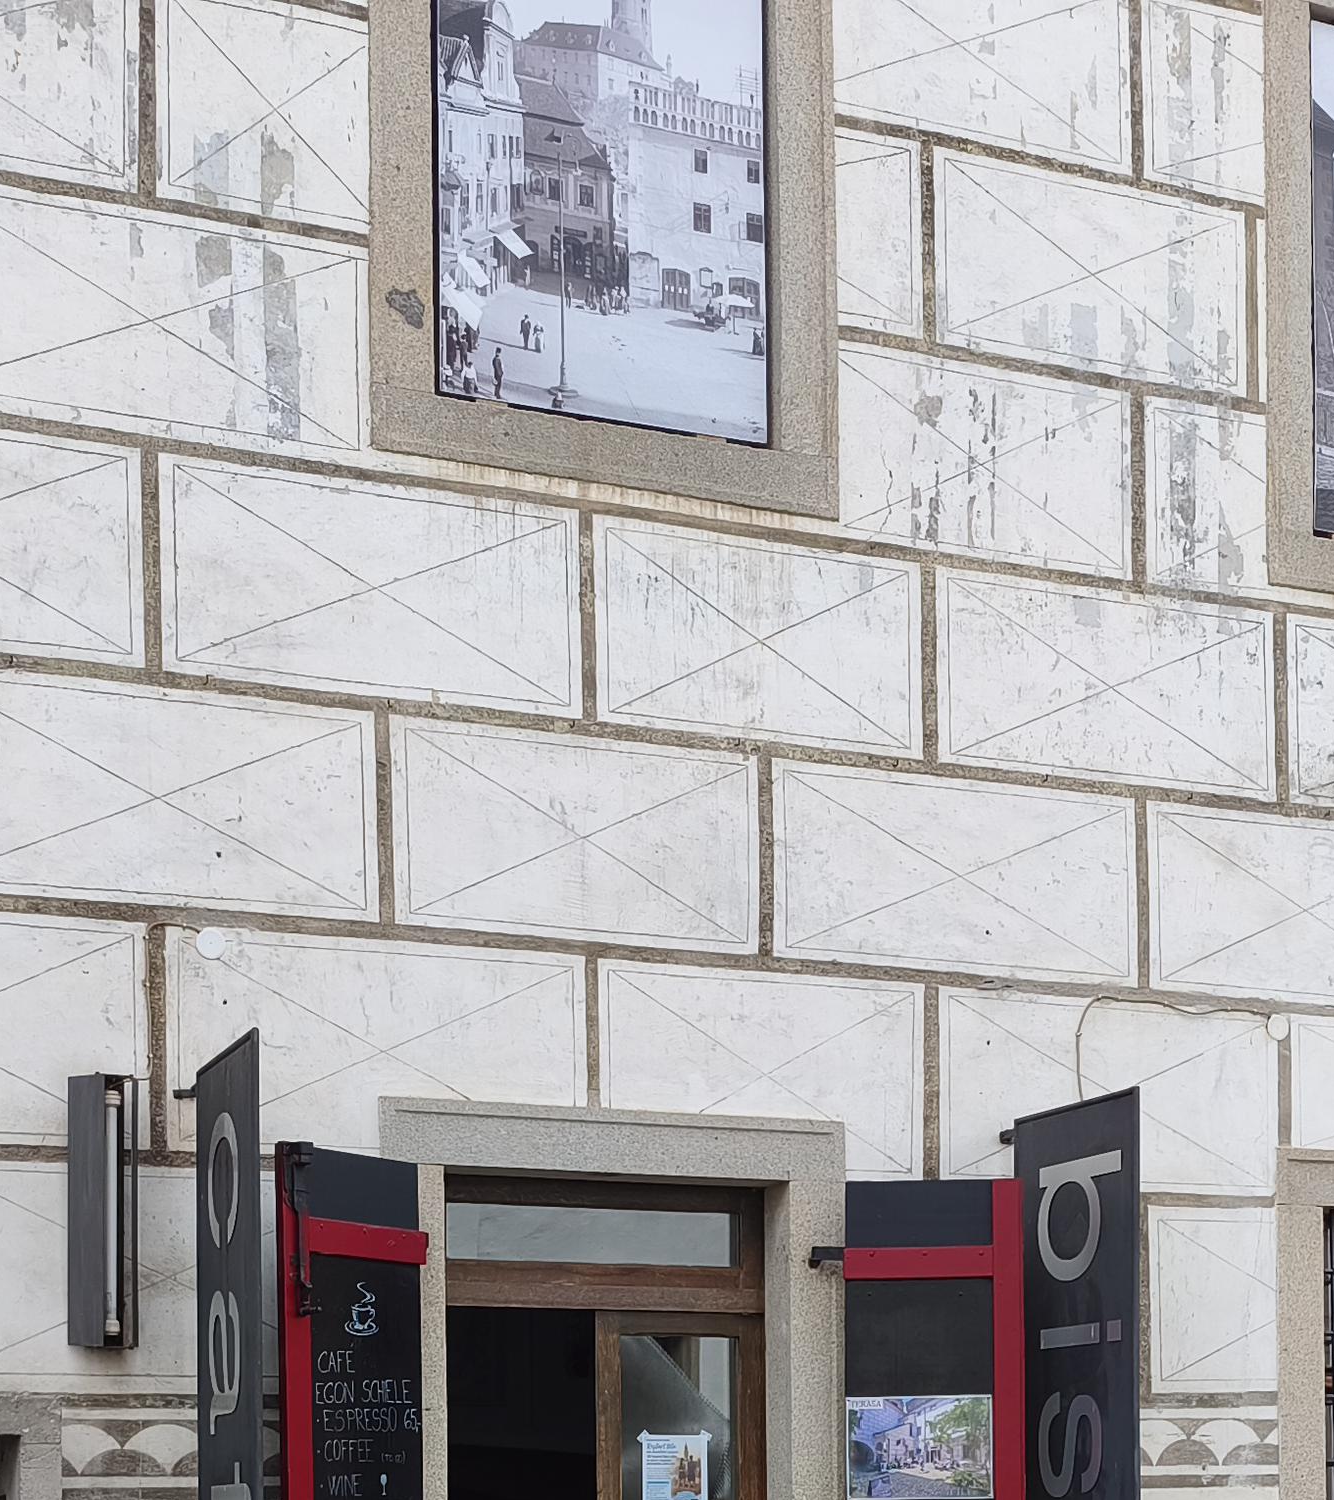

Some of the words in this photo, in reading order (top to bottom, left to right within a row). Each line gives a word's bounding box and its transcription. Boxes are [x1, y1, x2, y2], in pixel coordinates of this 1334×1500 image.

[315, 1380, 354, 1404] EGON
[323, 1406, 397, 1432] ESPRESSO
[323, 1438, 374, 1463] COFFEE
[327, 1473, 363, 1497] WINE
